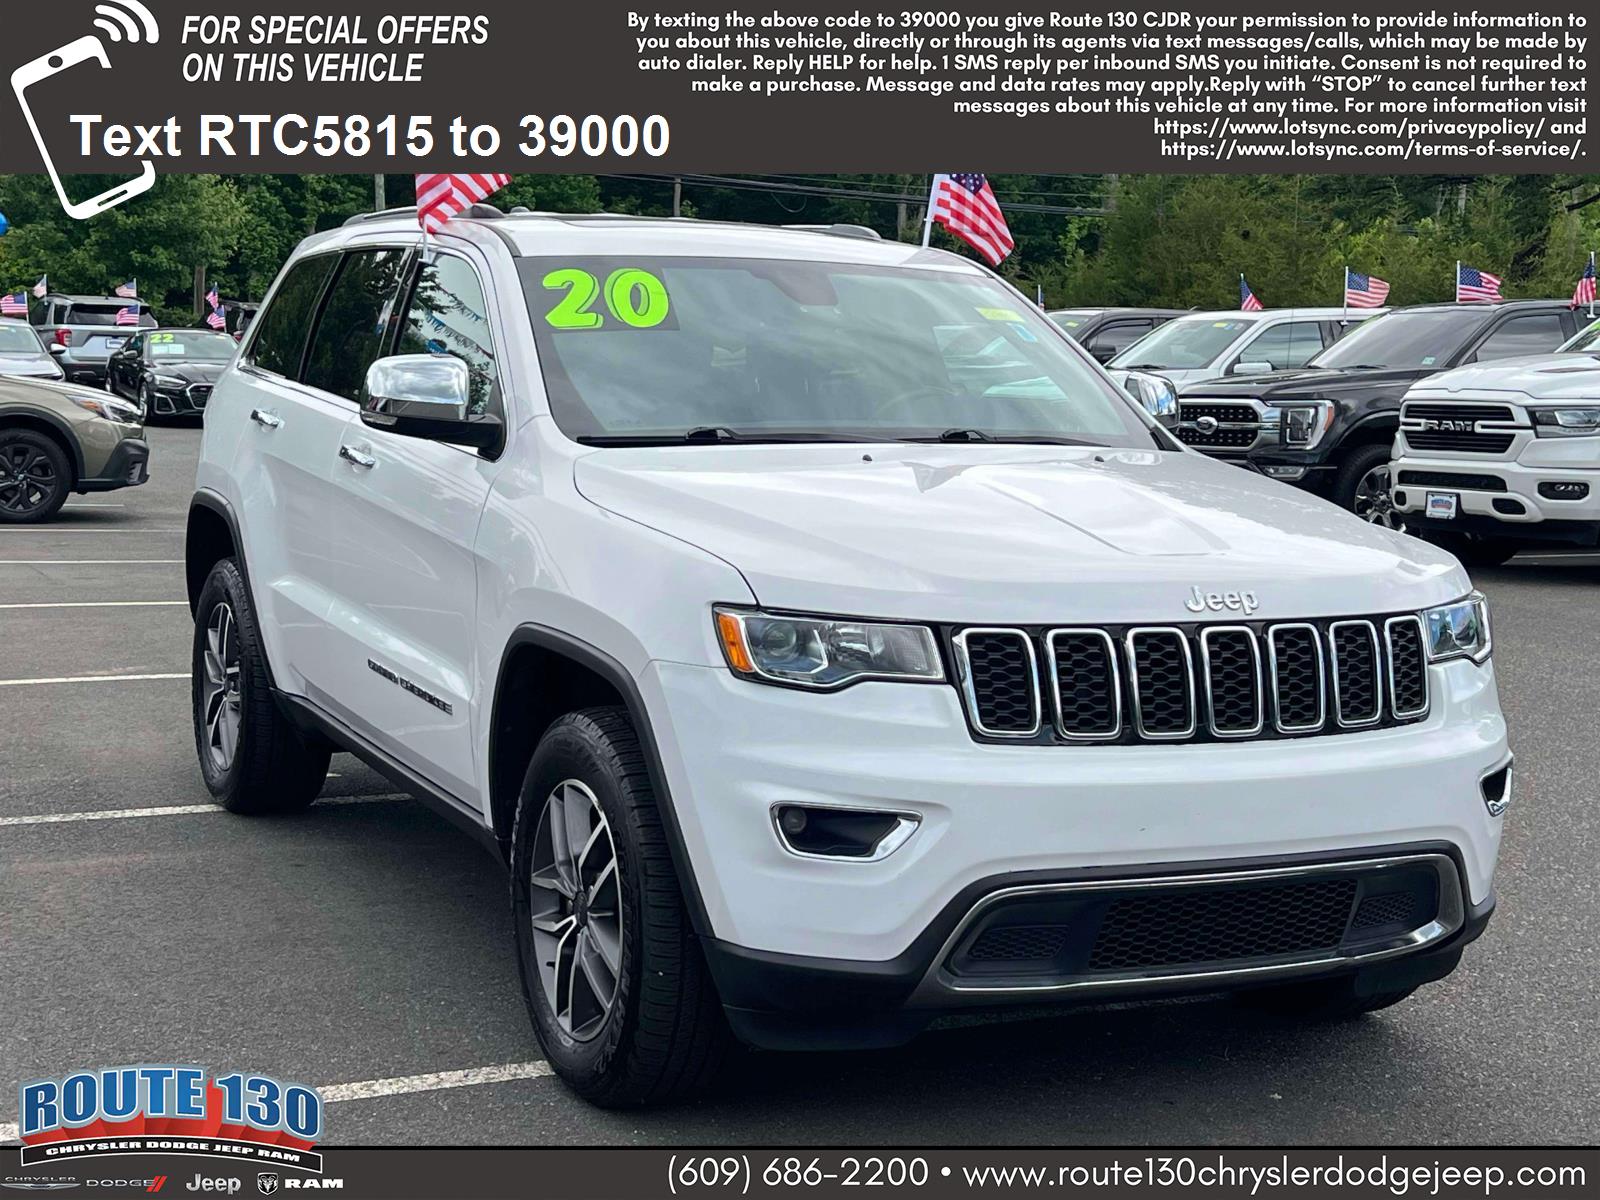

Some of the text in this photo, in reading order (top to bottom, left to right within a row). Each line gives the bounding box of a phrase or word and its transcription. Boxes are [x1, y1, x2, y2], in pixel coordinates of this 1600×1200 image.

[542, 268, 669, 329] 20
[150, 333, 175, 344] 22
[1424, 420, 1473, 432] RAM
[1184, 585, 1260, 616] Jeep
